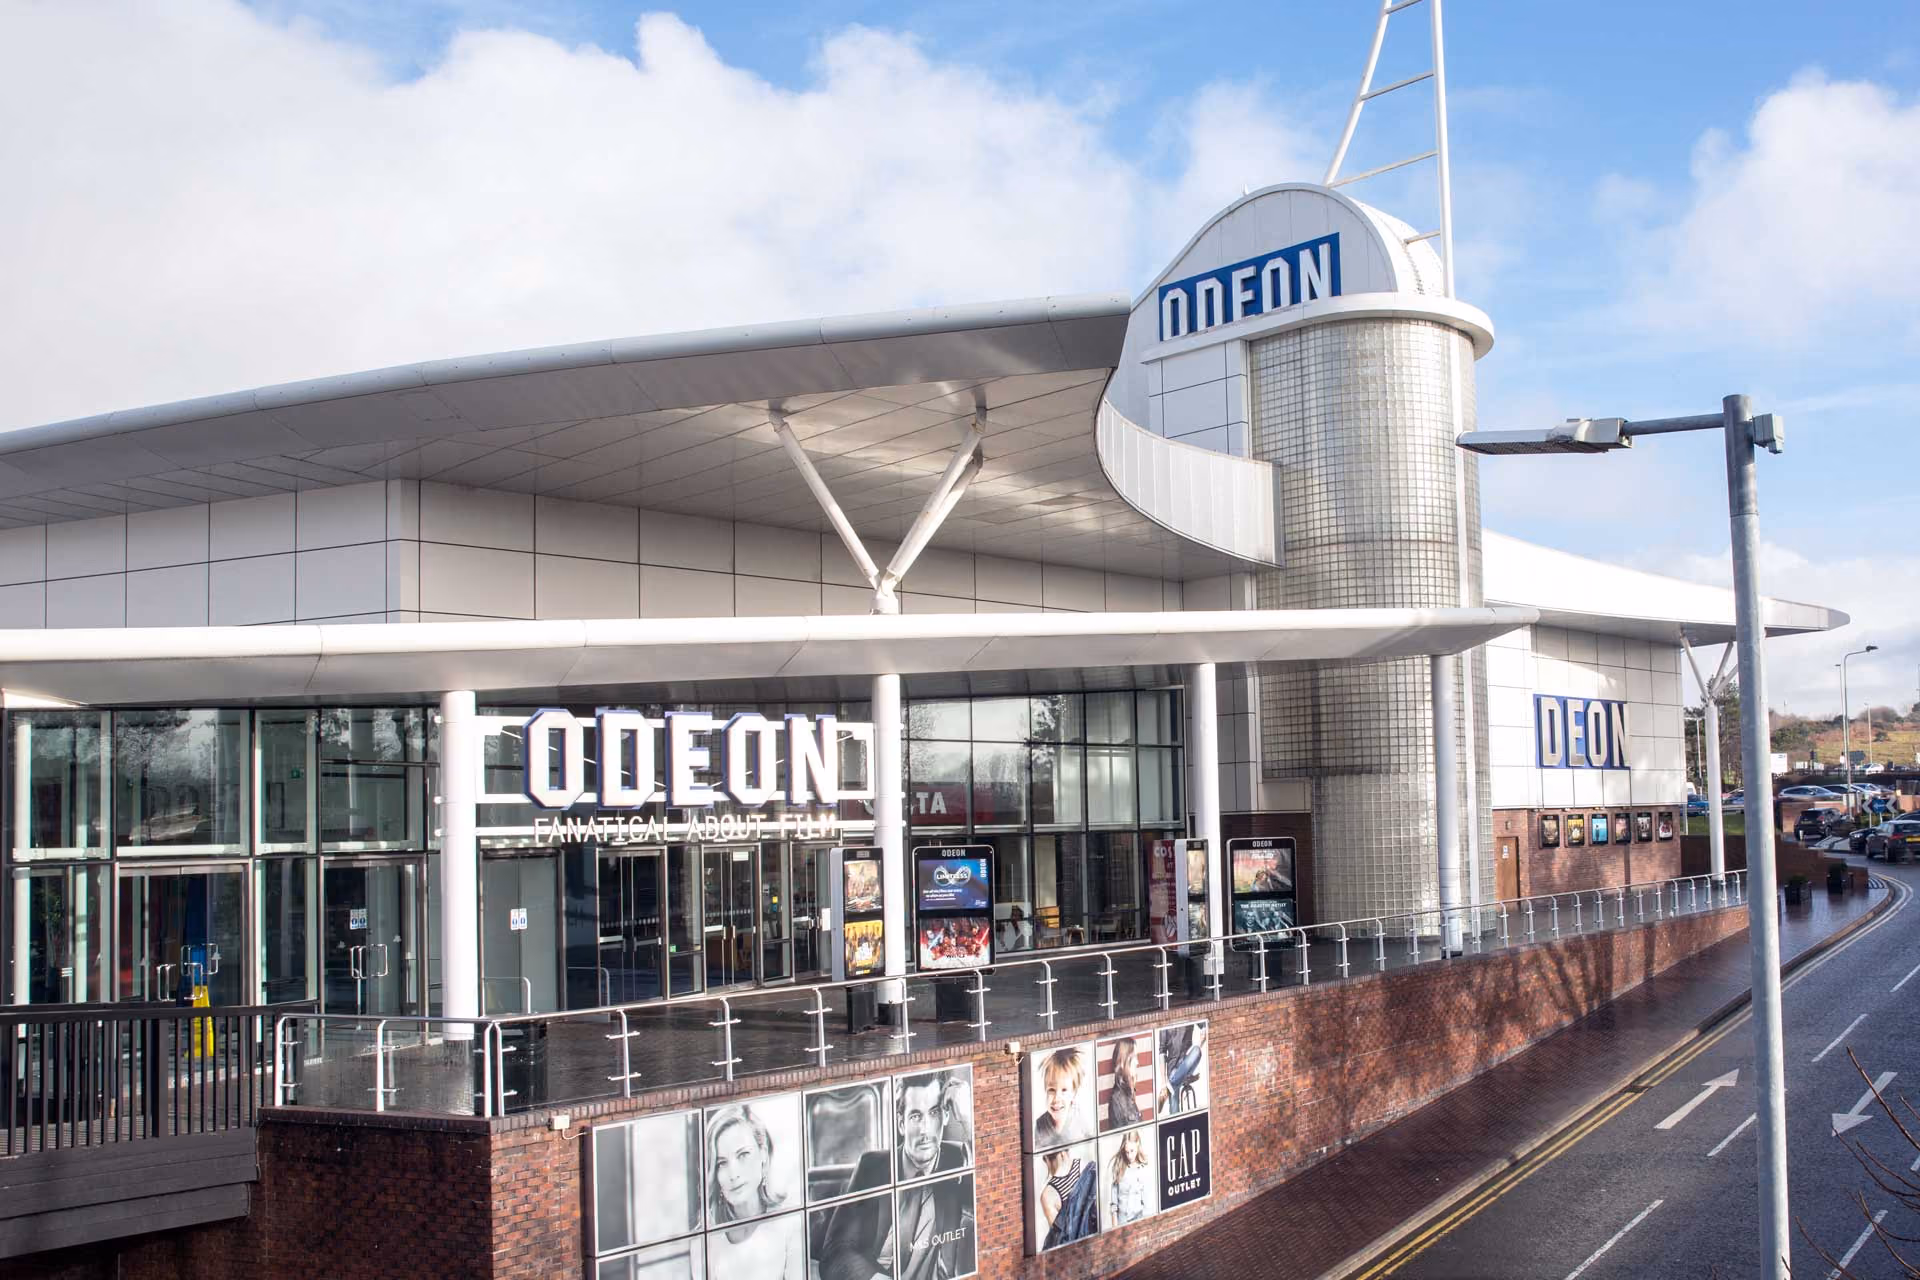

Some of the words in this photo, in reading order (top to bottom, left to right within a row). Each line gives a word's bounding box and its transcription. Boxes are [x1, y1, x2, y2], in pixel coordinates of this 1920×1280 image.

[1162, 242, 1332, 341] ODEON
[1537, 696, 1631, 768] DEON
[523, 708, 839, 810] ODEON
[533, 815, 671, 843] FANATICAL
[687, 814, 767, 840] ABOUT
[780, 812, 837, 838] FILM
[941, 849, 967, 857] ODEON
[1252, 840, 1273, 848] ODEON
[1166, 1129, 1201, 1182] GAP
[1168, 1178, 1201, 1196] OUTLET
[931, 1227, 967, 1247] OUTLET
